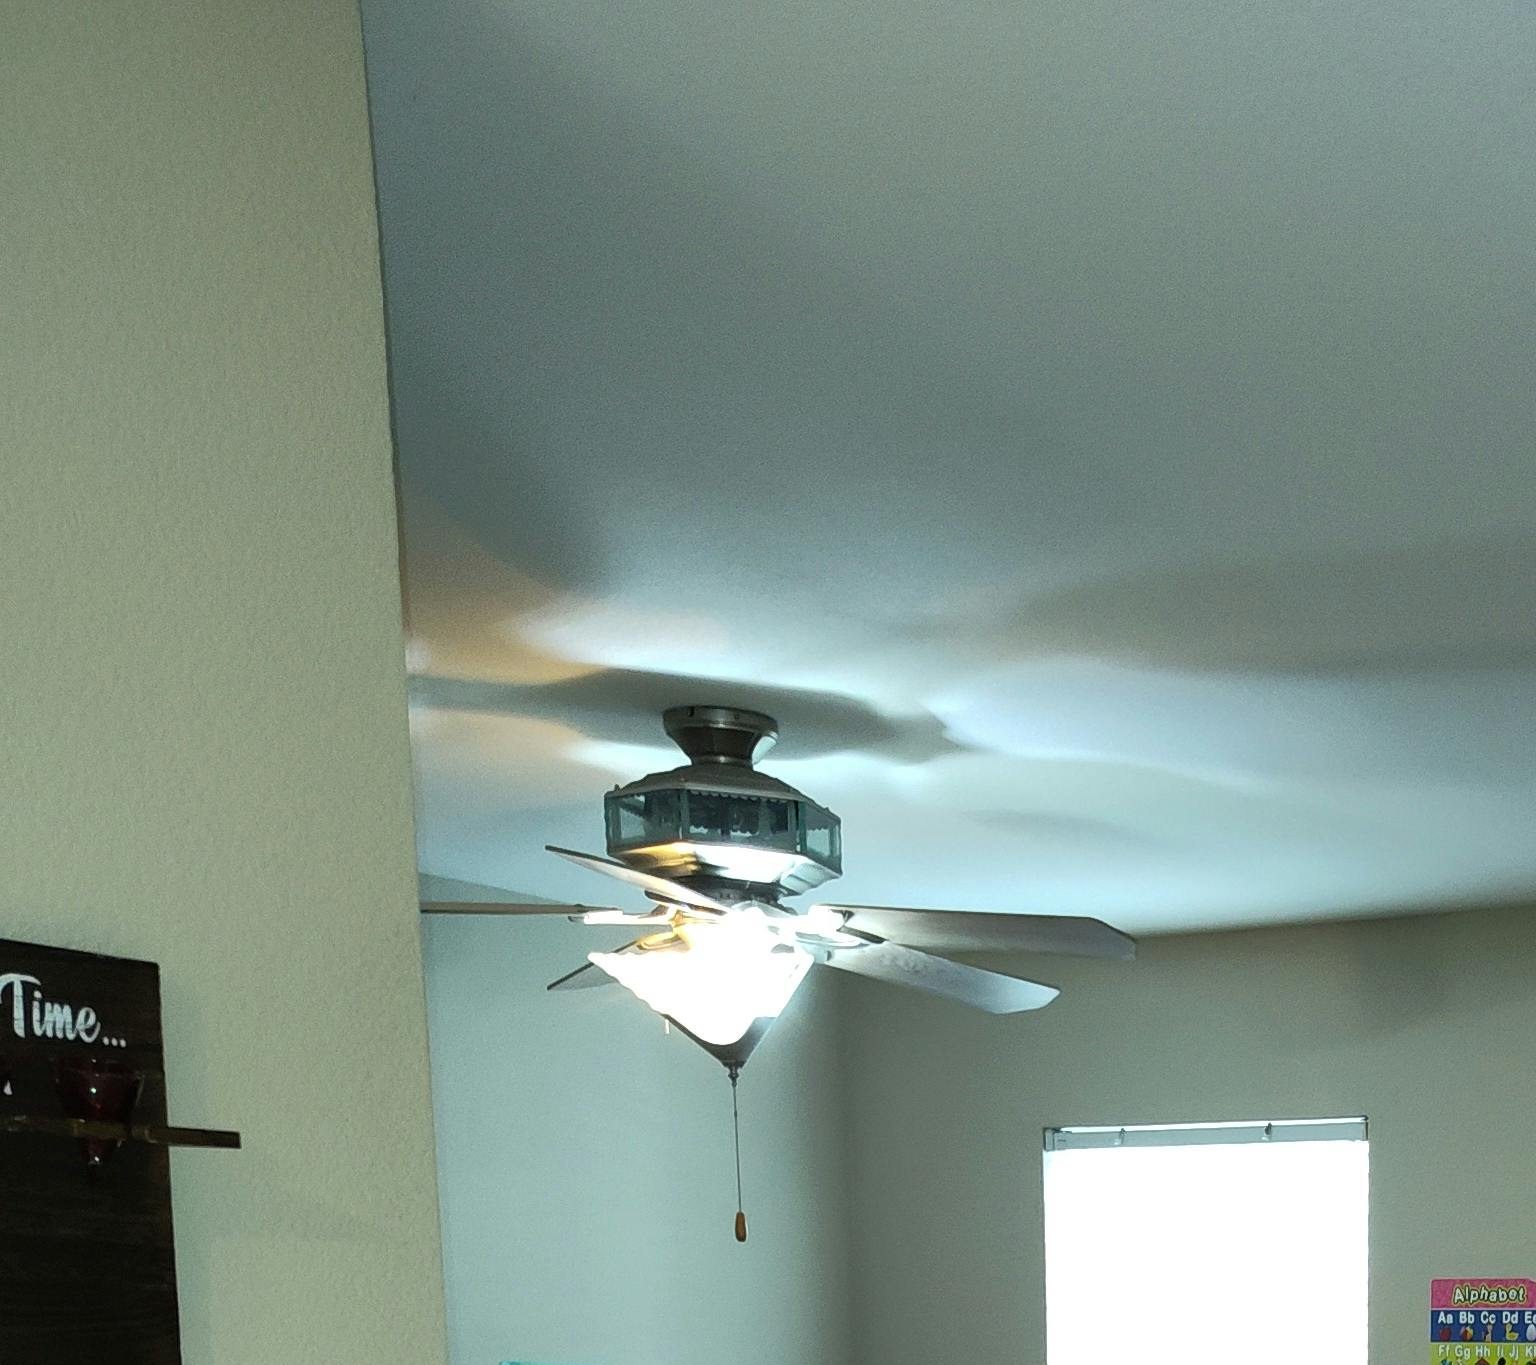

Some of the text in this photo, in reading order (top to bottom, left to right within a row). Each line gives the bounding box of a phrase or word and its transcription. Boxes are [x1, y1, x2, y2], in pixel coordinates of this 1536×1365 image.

[0, 973, 127, 1048] Time...
[1453, 1285, 1526, 1304] Alphabet
[1438, 1311, 1453, 1324] Aa
[1459, 1311, 1475, 1324] Bb
[1480, 1311, 1496, 1324] Cc
[1502, 1311, 1519, 1324] Dd
[1438, 1345, 1450, 1357] Ff
[1455, 1345, 1471, 1360] Gg
[1475, 1346, 1490, 1357] Hh
[1497, 1345, 1504, 1357] Ii
[1509, 1345, 1519, 1360] Jj
